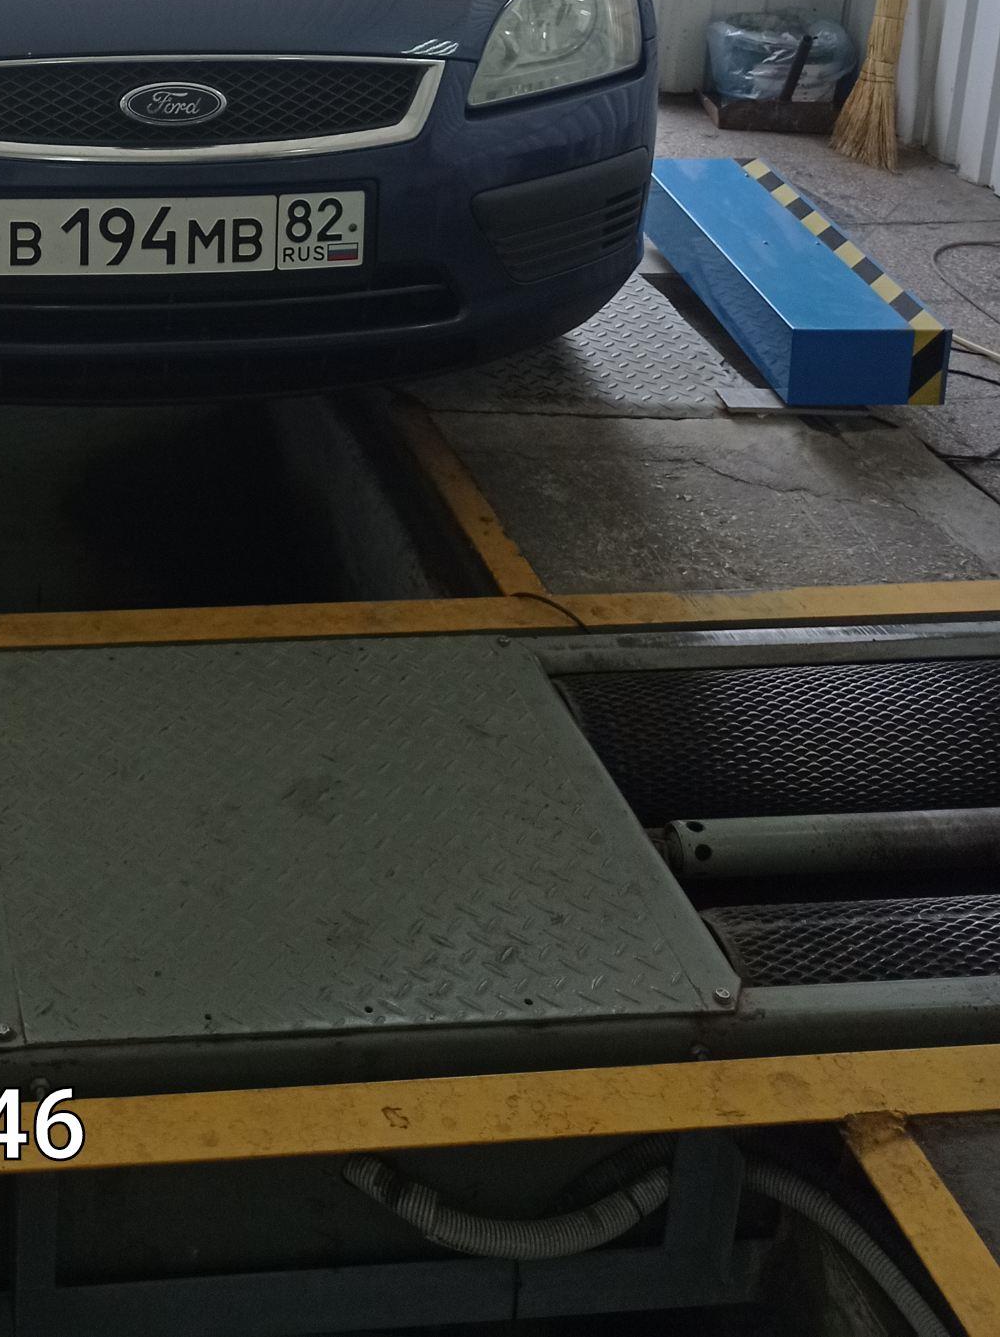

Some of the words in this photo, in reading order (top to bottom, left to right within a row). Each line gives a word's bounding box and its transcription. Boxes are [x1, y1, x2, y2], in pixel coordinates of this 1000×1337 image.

[146, 91, 202, 115] Ford
[285, 197, 343, 243] 82
[282, 246, 325, 263] RUS
